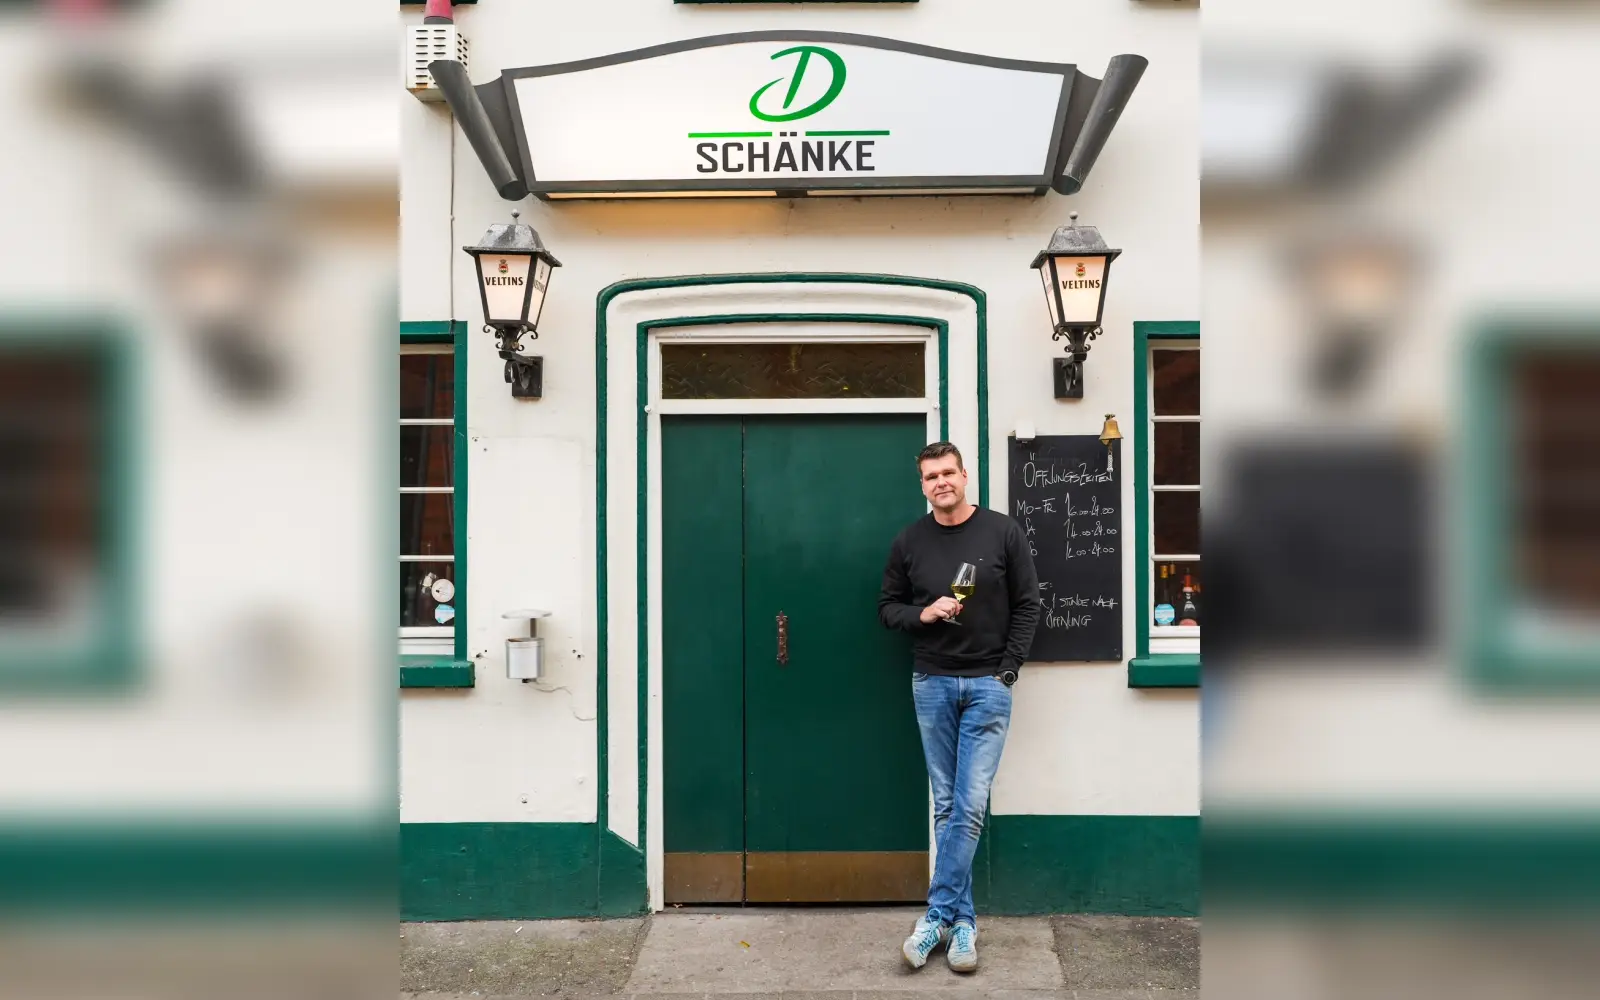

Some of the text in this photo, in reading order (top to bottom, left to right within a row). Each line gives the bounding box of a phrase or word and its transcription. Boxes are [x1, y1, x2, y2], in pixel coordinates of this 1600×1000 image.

[696, 131, 875, 173] SCHÄNKE
[485, 276, 523, 286] VELTINS
[1062, 279, 1100, 289] VELTINS
